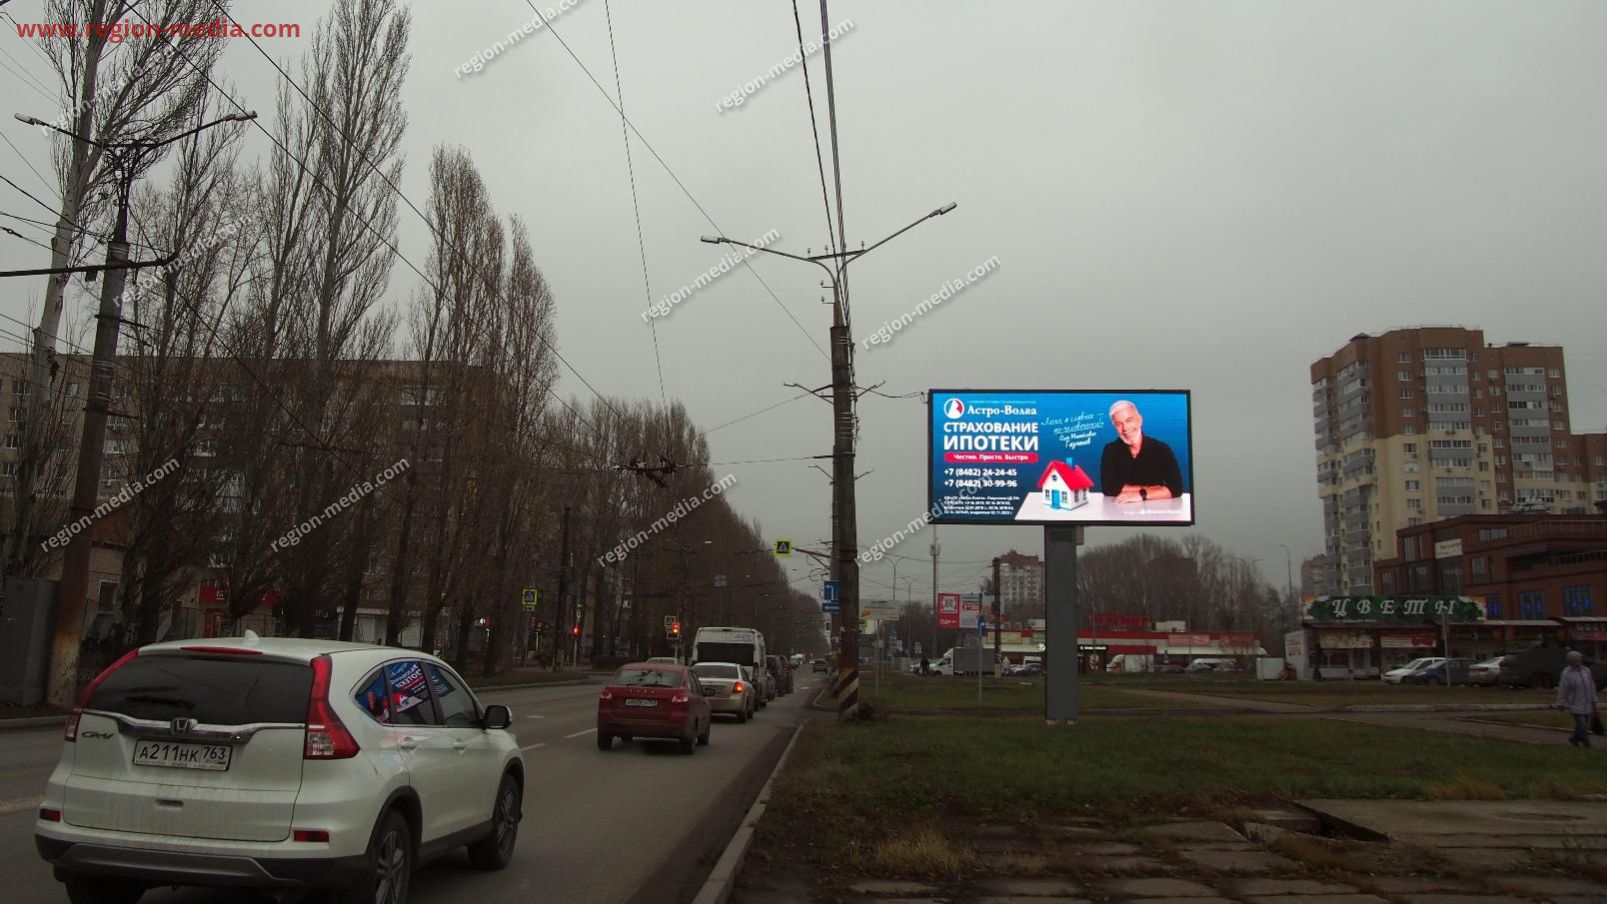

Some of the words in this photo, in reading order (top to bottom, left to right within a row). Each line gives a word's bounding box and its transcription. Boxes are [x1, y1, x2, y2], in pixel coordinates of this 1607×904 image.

[967, 405, 1037, 418] Астро-Волга
[943, 422, 1038, 433] СТРАХОВАНИЕ
[943, 435, 1039, 451] ИПОТЕКИ
[1005, 453, 1029, 461] Быстро
[944, 468, 954, 476] +7
[955, 468, 981, 477] (8482)
[982, 468, 1017, 477] 24-24-45
[944, 479, 954, 487] +7
[1331, 599, 1457, 618] ЦВЕТЫ
[203, 746, 227, 760] 763
